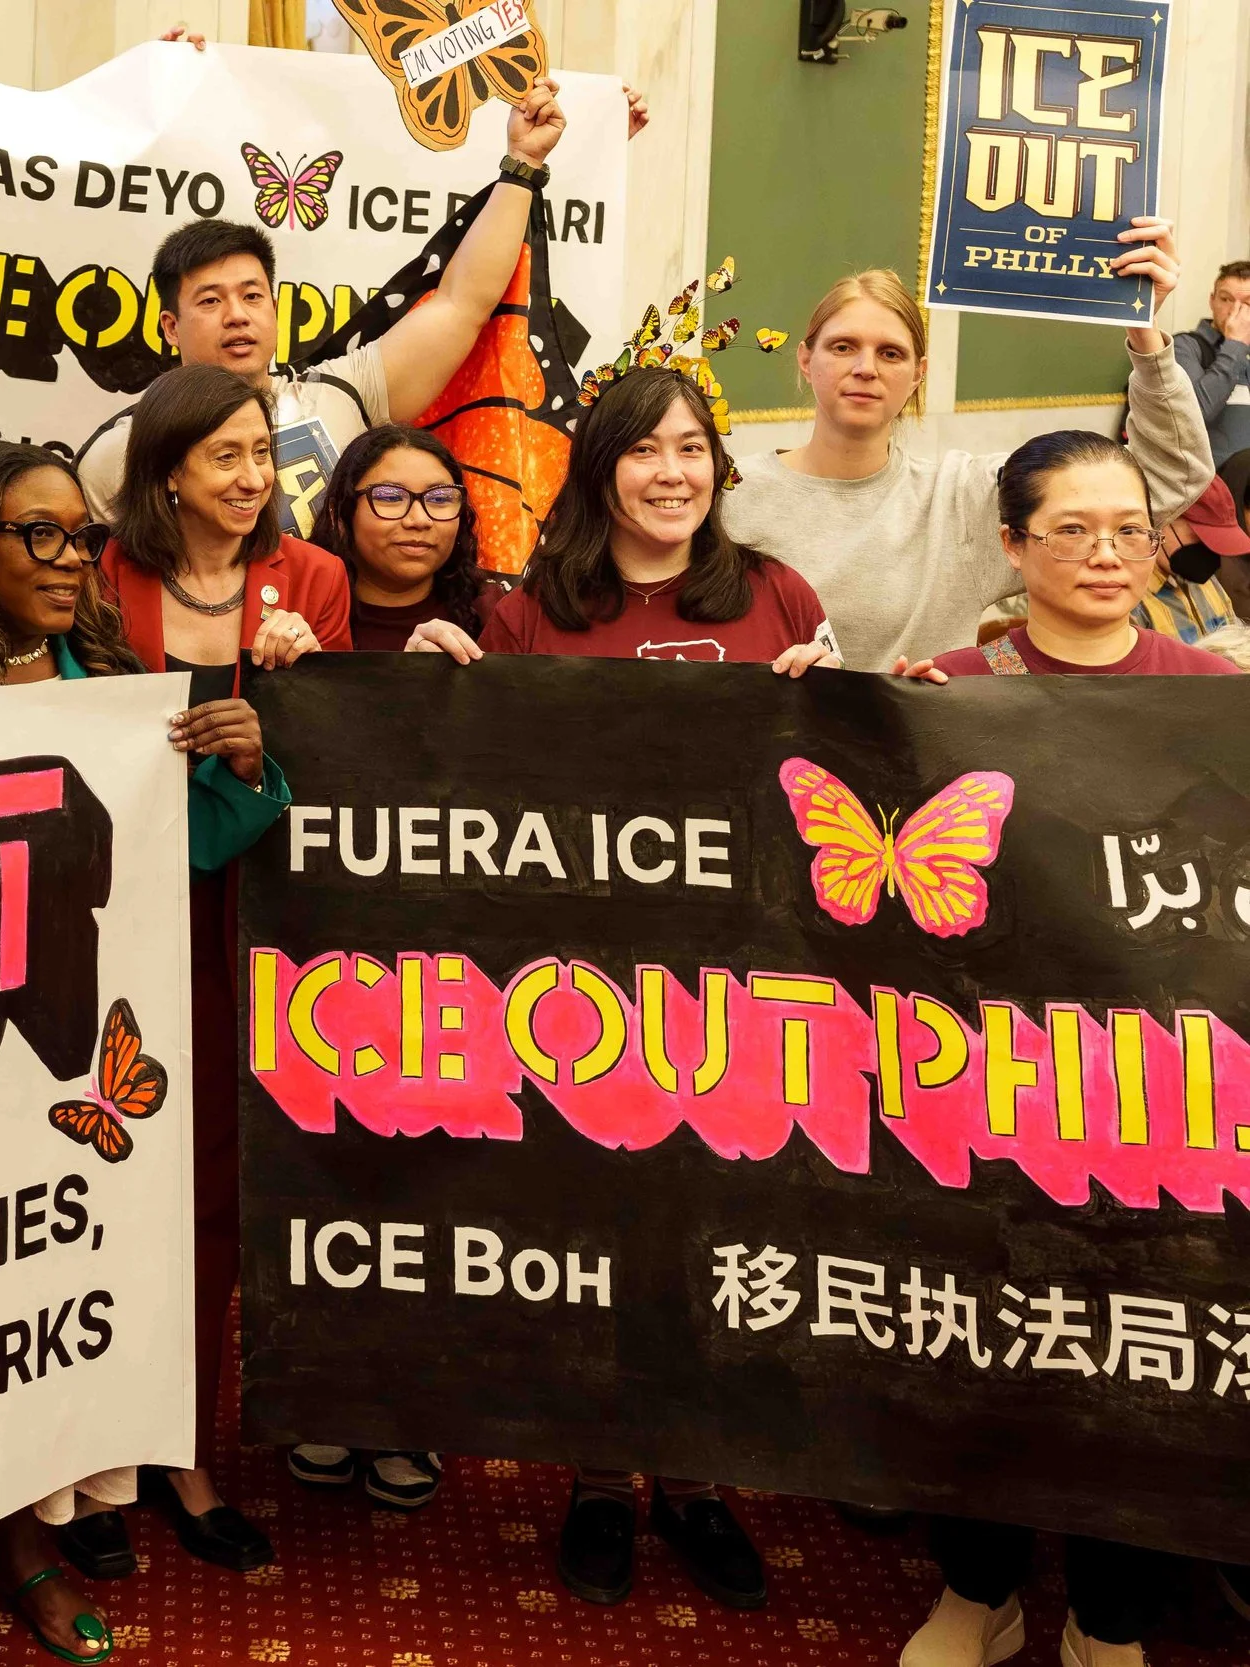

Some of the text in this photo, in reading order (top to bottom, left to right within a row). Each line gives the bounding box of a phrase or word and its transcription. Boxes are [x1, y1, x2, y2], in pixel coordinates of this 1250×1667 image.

[401, 0, 524, 83] I'M VOTING YES
[976, 24, 1143, 133] ICE
[74, 160, 226, 219] DEYO
[349, 184, 431, 235] ICE
[964, 126, 1140, 222] OUT
[963, 245, 1119, 280] PHILLY
[1024, 225, 1068, 245] OF
[289, 805, 733, 889] FUERA ICE
[251, 949, 468, 1083] ICE
[503, 960, 838, 1109] OUT
[290, 1217, 426, 1294] ICE
